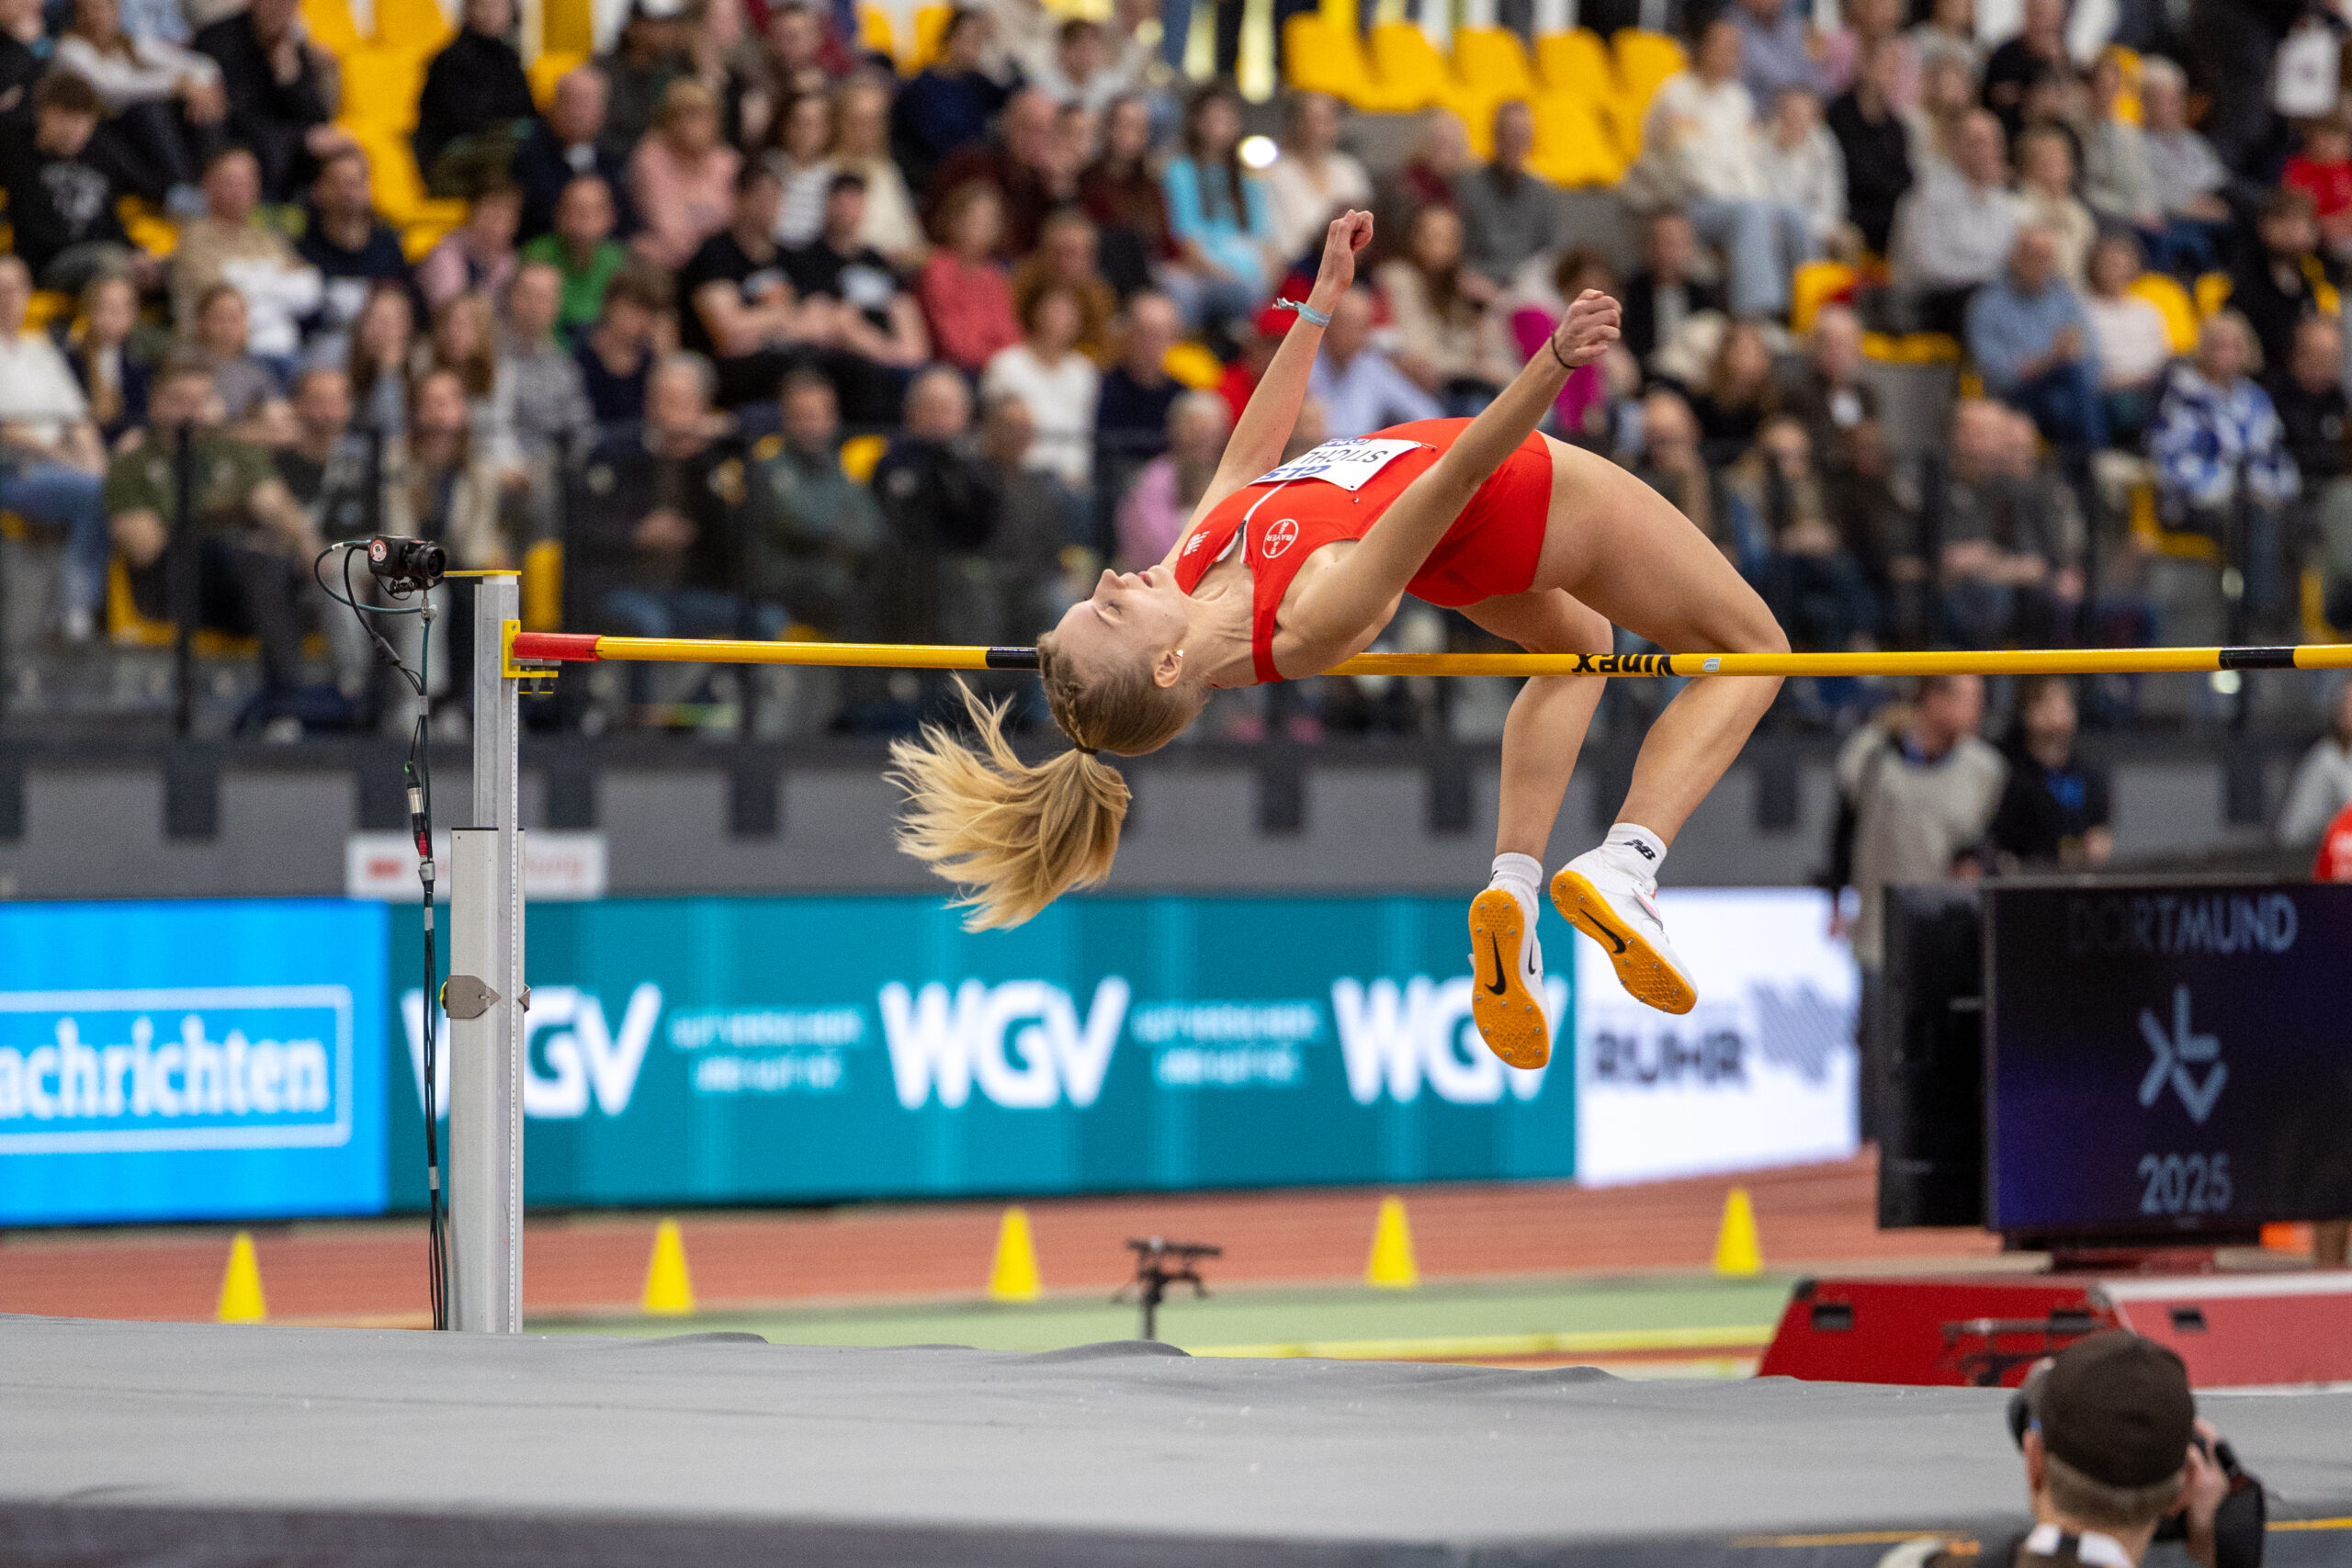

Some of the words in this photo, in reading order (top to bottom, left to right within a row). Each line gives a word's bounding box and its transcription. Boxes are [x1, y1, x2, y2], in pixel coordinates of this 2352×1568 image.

[1257, 465, 1331, 481] GLS
[2066, 892, 2299, 955] DORTMUND
[877, 975, 1131, 1111] WGV
[2137, 1153, 2233, 1215] 2025
